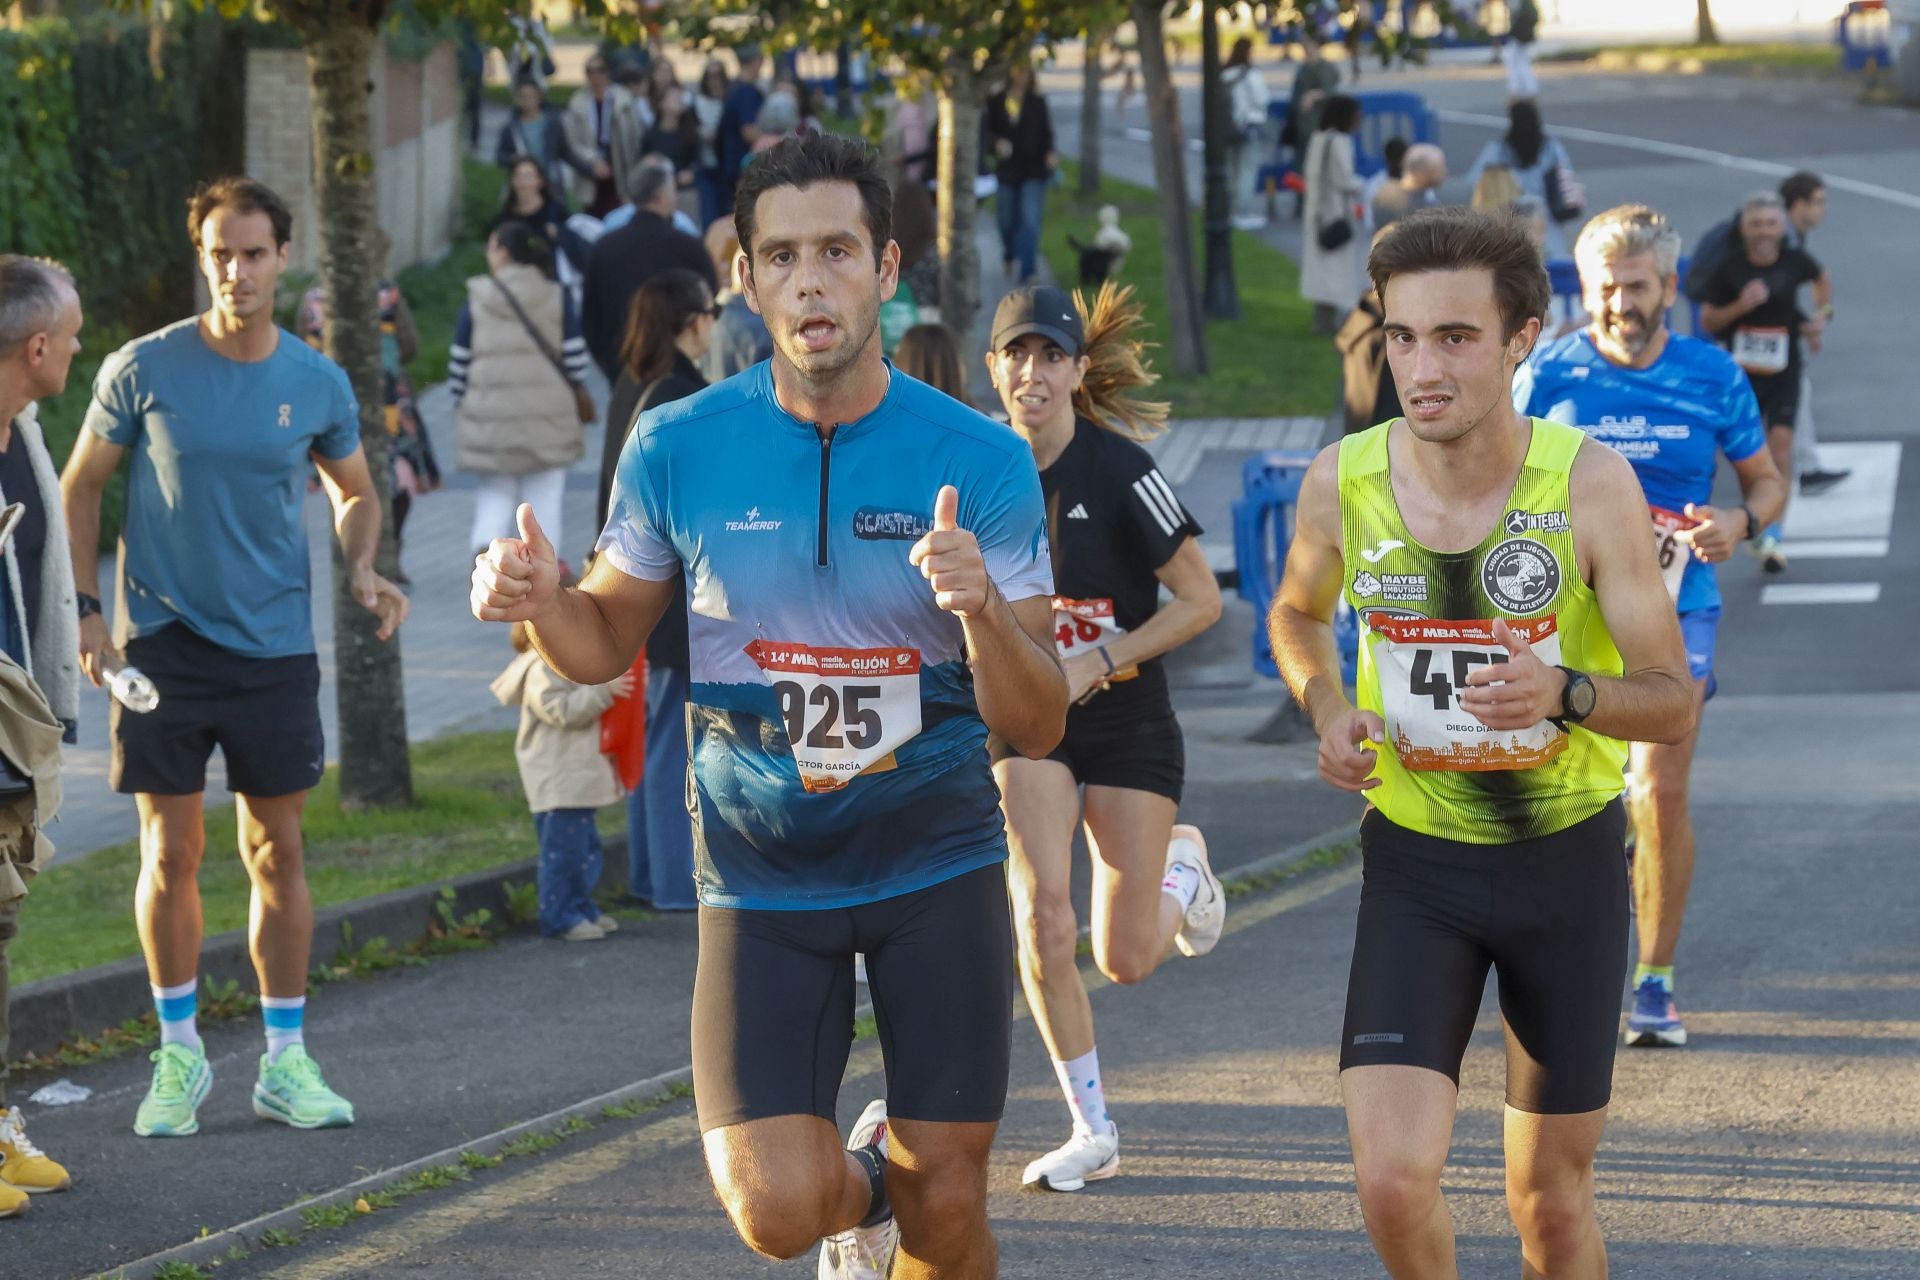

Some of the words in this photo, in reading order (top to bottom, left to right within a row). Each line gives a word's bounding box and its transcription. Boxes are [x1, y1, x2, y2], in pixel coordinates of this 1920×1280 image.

[1527, 512, 1568, 529] INTEGRA
[725, 521, 782, 532] TEAMERGY
[1488, 547, 1509, 571] CIUDAD
[1523, 543, 1554, 567] LUGONES
[1381, 575, 1426, 584] MAYBE
[1493, 592, 1509, 607] CLUB
[1509, 602, 1519, 610] DE
[1519, 588, 1553, 611] ATLETISMO
[1423, 628, 1460, 638] MBA
[821, 661, 850, 669] maratón
[851, 656, 889, 670] GIJÓN
[773, 681, 882, 750] 925
[1446, 724, 1474, 733] DIEGO
[826, 761, 862, 771] GARCÍA
